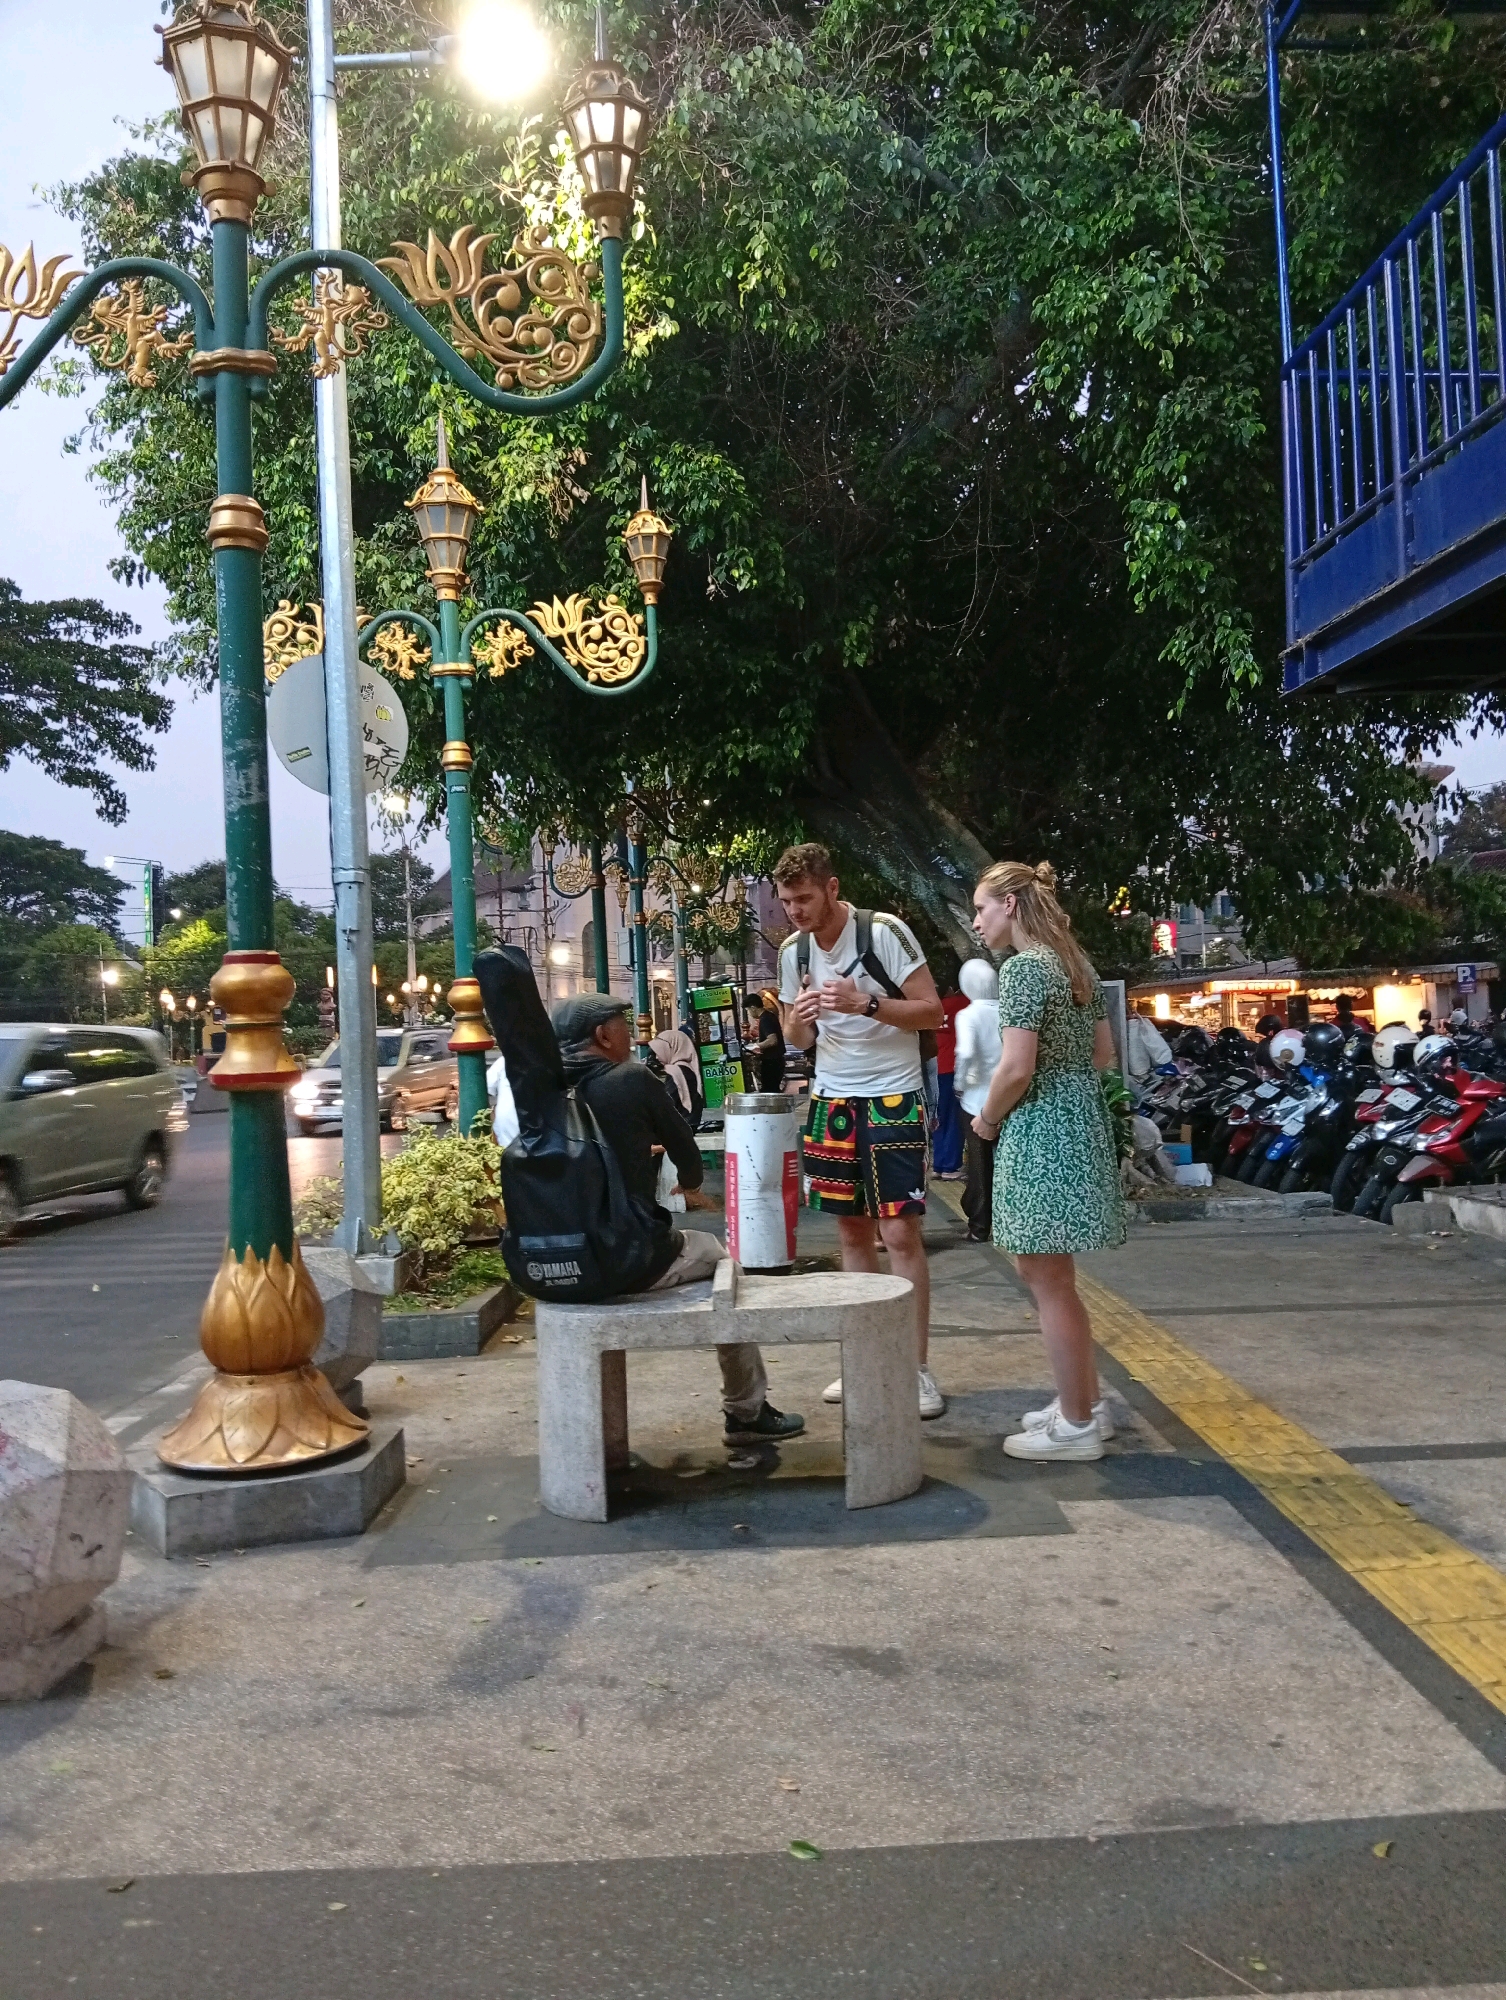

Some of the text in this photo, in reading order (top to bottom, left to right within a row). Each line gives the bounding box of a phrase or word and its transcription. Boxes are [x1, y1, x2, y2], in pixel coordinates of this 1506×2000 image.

[1458, 966, 1470, 982] P
[705, 1065, 737, 1077] BAKSO
[542, 1261, 582, 1277] YAMAHA
